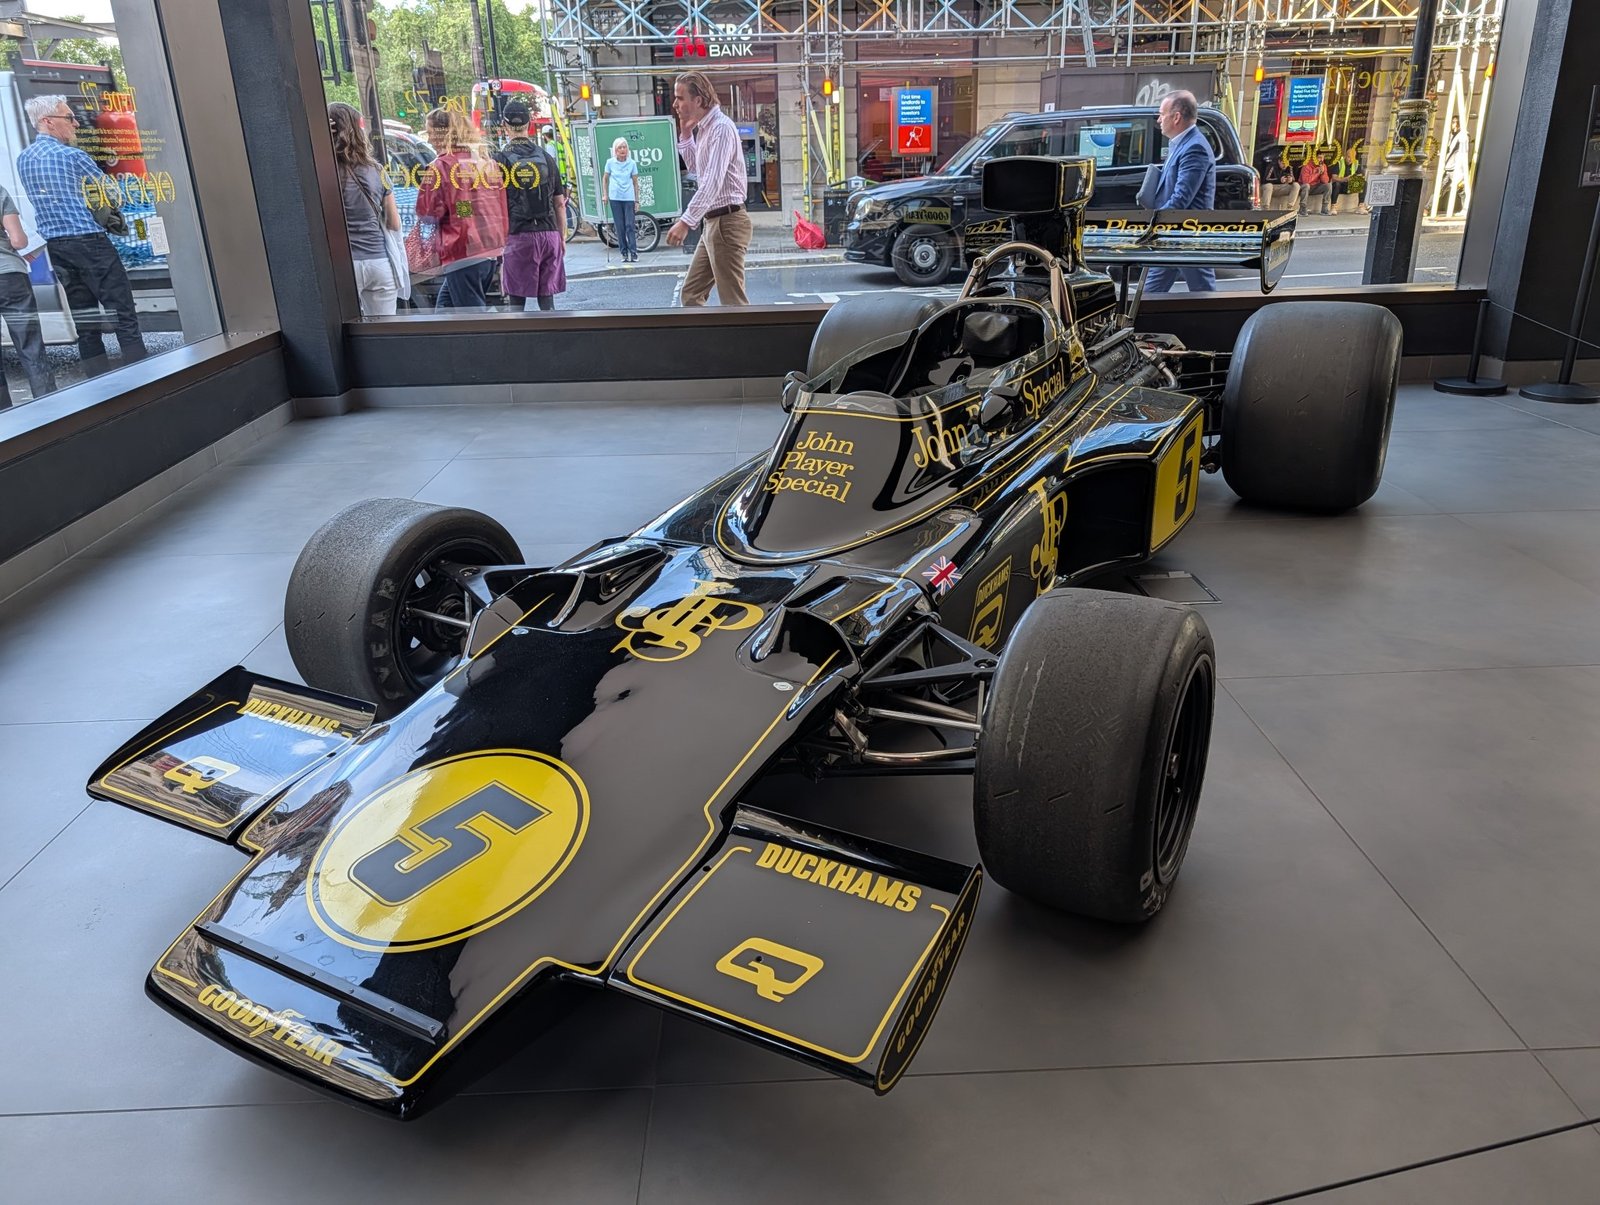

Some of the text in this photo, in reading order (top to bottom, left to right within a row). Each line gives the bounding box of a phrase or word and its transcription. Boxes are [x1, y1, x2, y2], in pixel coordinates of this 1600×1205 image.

[708, 43, 754, 57] BANK
[1180, 218, 1270, 236] Special
[1022, 357, 1066, 420] Special
[778, 451, 854, 478] Player
[796, 431, 854, 456] John
[912, 423, 968, 468] John
[763, 472, 853, 504] Special
[1174, 423, 1196, 526] 5
[976, 563, 1010, 608] DUCKHAMS
[237, 698, 342, 737] DUCKHAMS
[164, 756, 240, 794] Q
[349, 780, 550, 906] 5
[755, 842, 922, 912] DUCKHAMS
[716, 936, 824, 1004] Q
[896, 912, 966, 1054] GOODYEAR
[198, 984, 343, 1066] GOODYEAR
